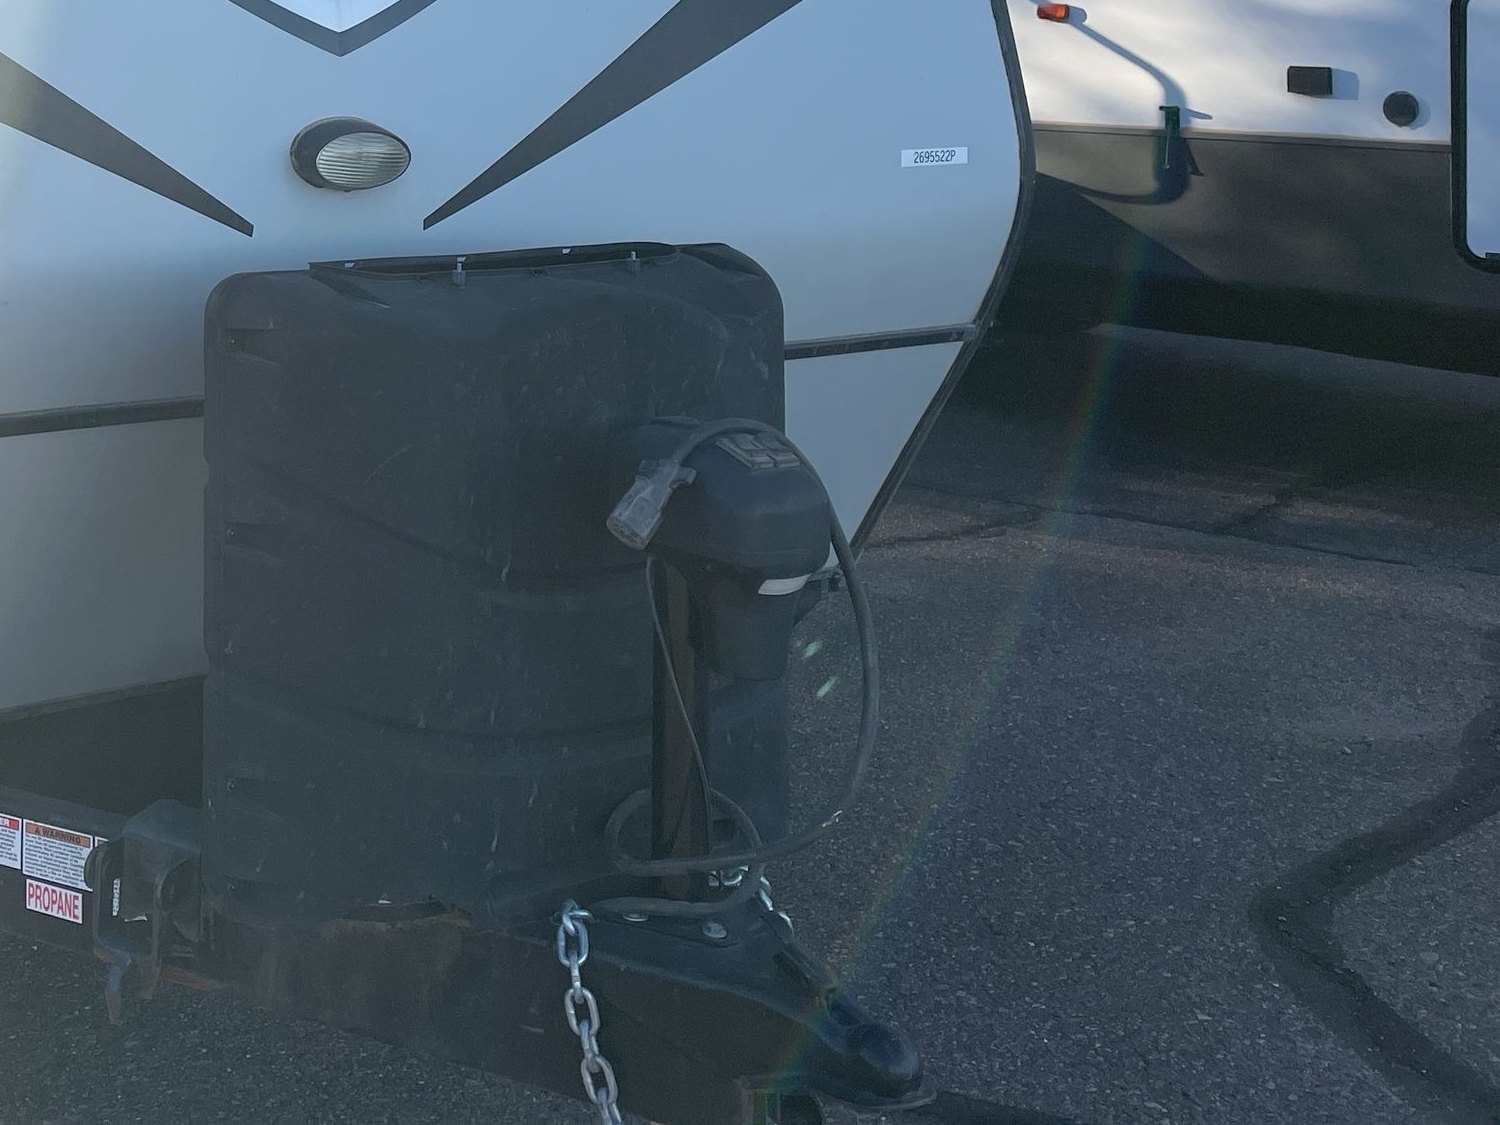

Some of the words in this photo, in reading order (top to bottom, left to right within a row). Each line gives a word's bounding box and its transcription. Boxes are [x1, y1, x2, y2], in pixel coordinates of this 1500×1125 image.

[913, 149, 956, 164] 2695522P
[43, 827, 82, 844] WARNING
[28, 882, 80, 921] PROPANE
